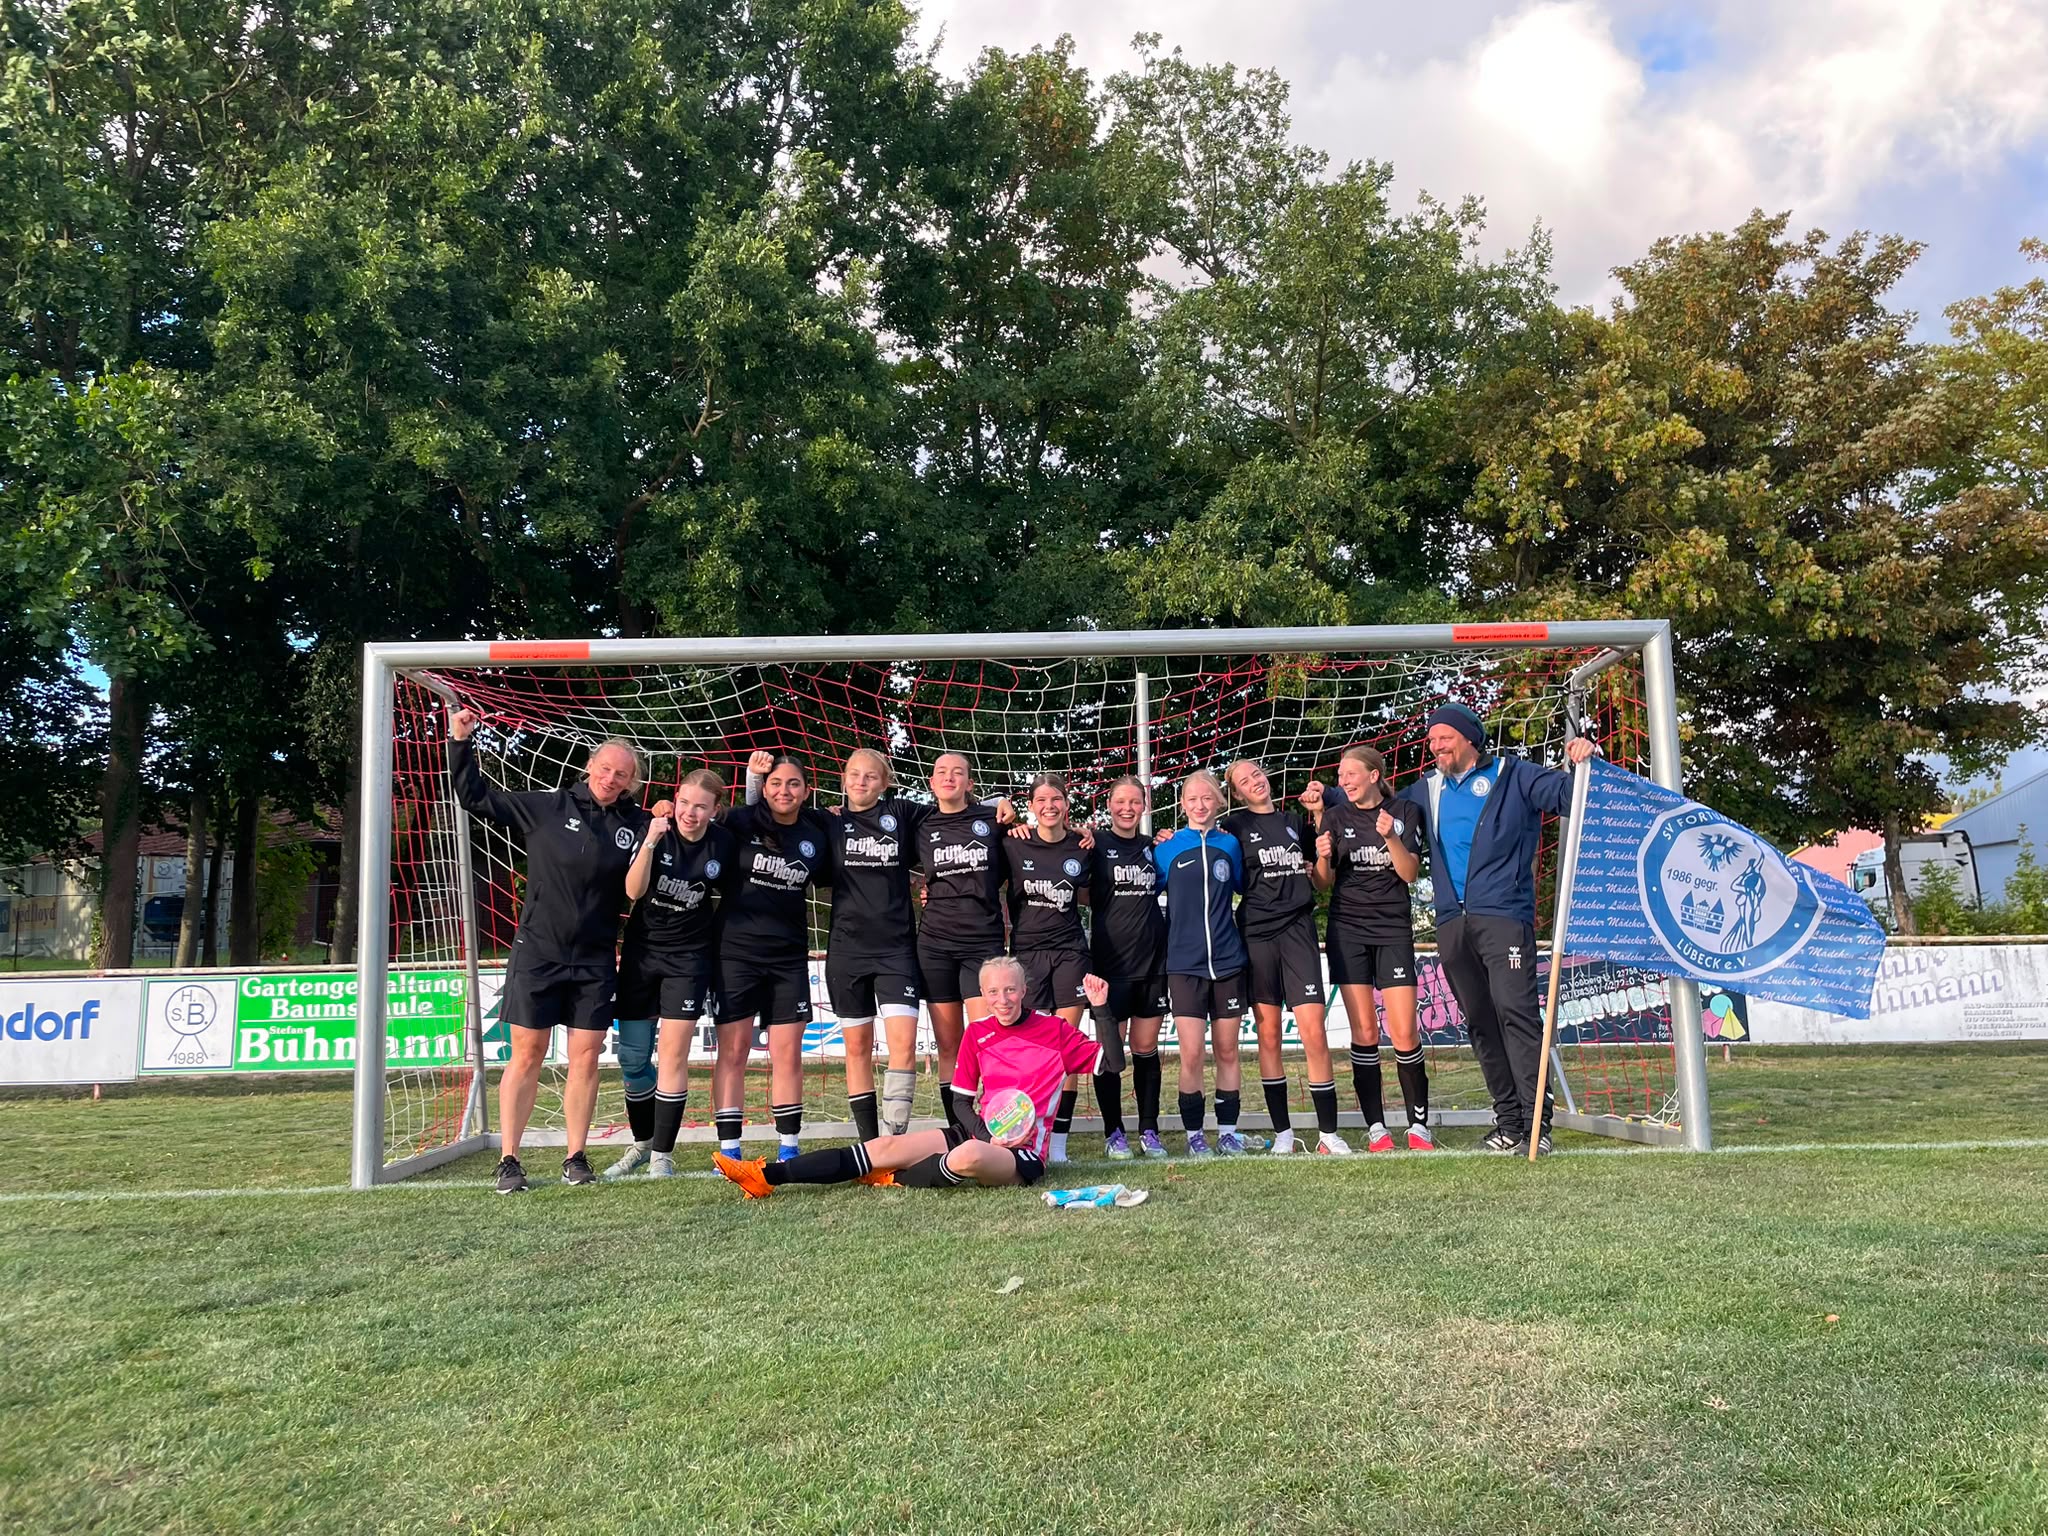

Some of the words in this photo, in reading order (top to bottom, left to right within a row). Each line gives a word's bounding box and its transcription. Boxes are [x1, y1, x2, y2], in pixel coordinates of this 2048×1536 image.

[1602, 800, 1640, 813] Lübecker
[1601, 816, 1641, 828] Mädchen
[1662, 822, 1675, 840] SV
[1604, 833, 1640, 845] Lübecker
[1666, 868, 1693, 884] 1986
[1694, 876, 1718, 892] gegr.
[13, 902, 57, 926] Nedlloyd
[1607, 916, 1646, 928] Mädchen
[1566, 932, 1608, 944] Mädchen
[1610, 933, 1647, 945] Lübecker
[1811, 930, 1853, 944] Lübecker
[1608, 950, 1646, 962] Mädchen
[1676, 938, 1721, 970] LÜBECK
[1724, 956, 1751, 970] e.V.
[1808, 946, 1855, 960] Mädchen
[1508, 957, 1521, 969] TR
[1808, 962, 1853, 976] Lübecker
[242, 975, 464, 999] Gartengealtung
[1763, 974, 1807, 987] Lübecker
[1809, 976, 1855, 992] Mädchen
[1810, 993, 1852, 1008] Lübecker
[269, 1025, 304, 1035] Stefan
[173, 1052, 205, 1066] 1988
